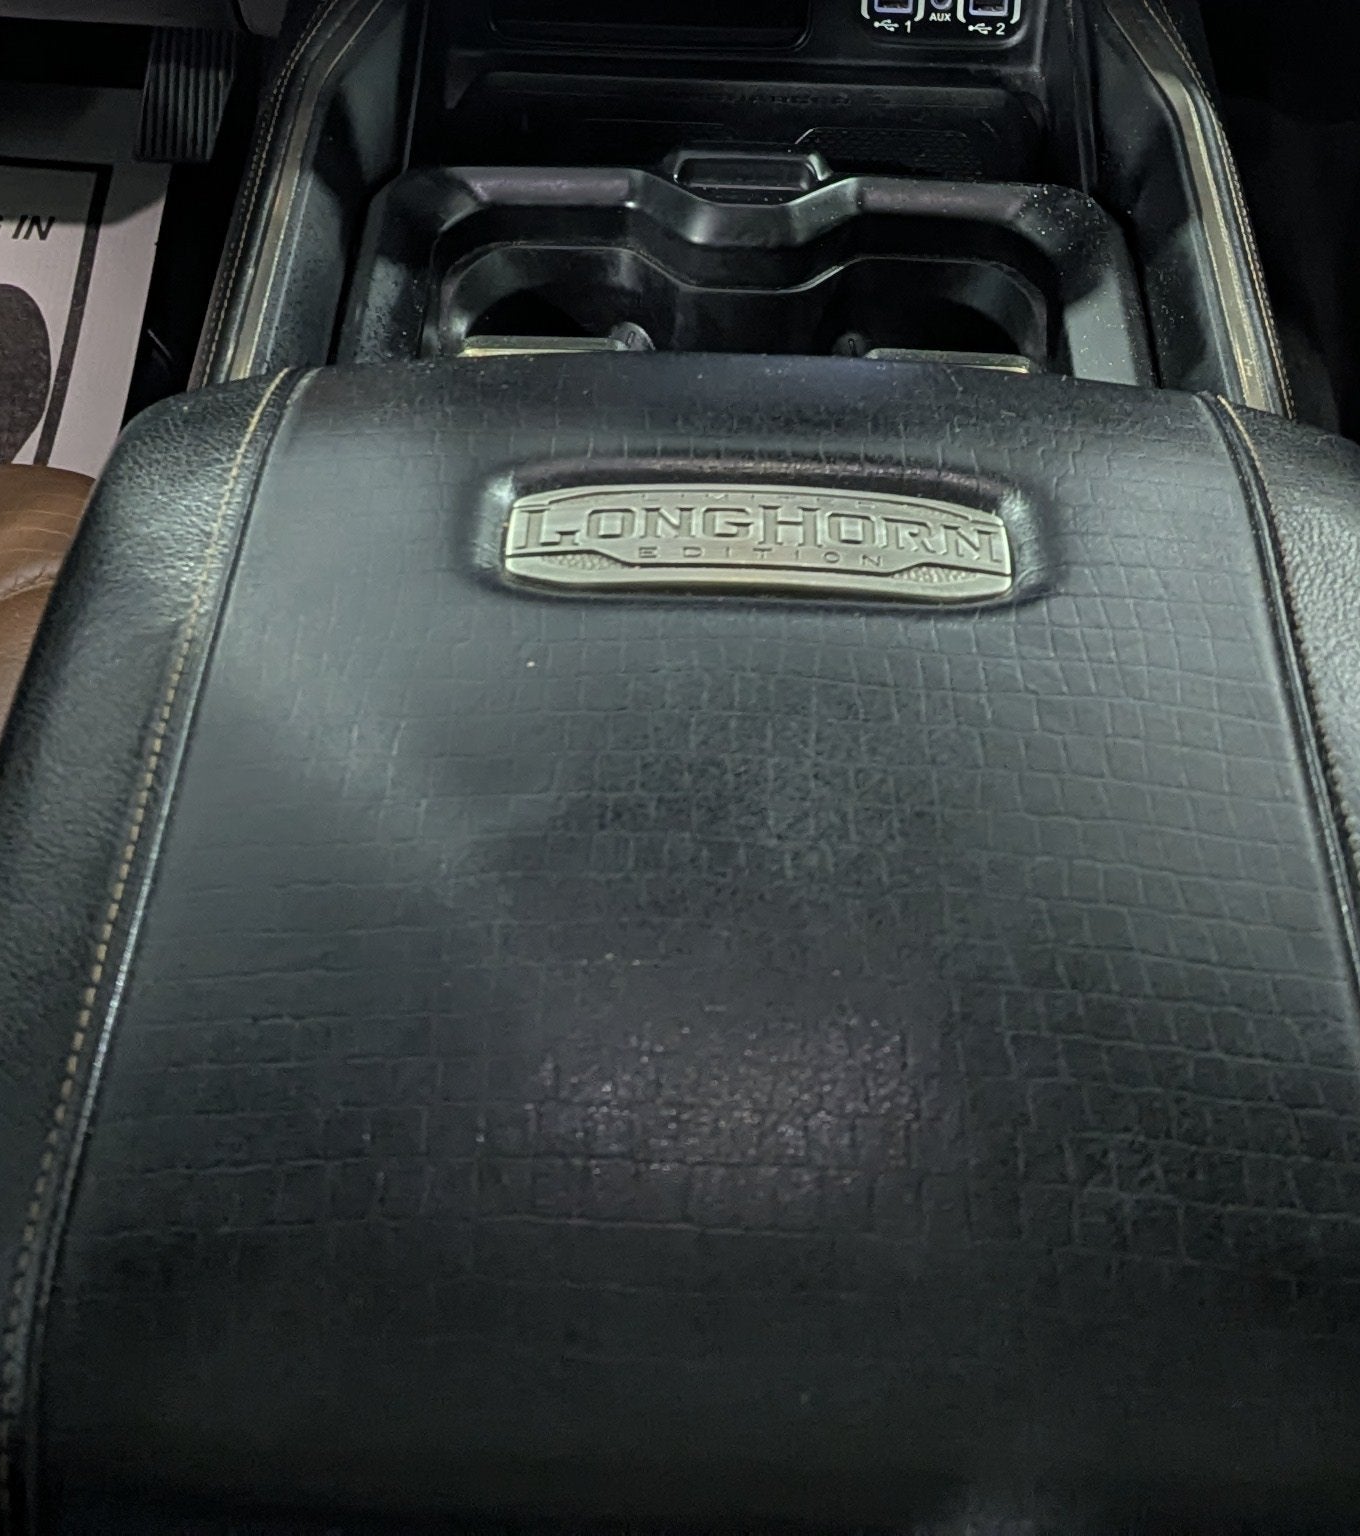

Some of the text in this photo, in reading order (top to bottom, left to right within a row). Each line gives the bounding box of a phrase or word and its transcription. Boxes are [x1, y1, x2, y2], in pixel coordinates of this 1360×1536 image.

[929, 12, 951, 22] AUX
[905, 21, 912, 33] 1
[996, 23, 1005, 35] 2
[12, 214, 56, 241] IN
[517, 504, 1005, 564] LONGHORN
[639, 547, 885, 569] EDITION
